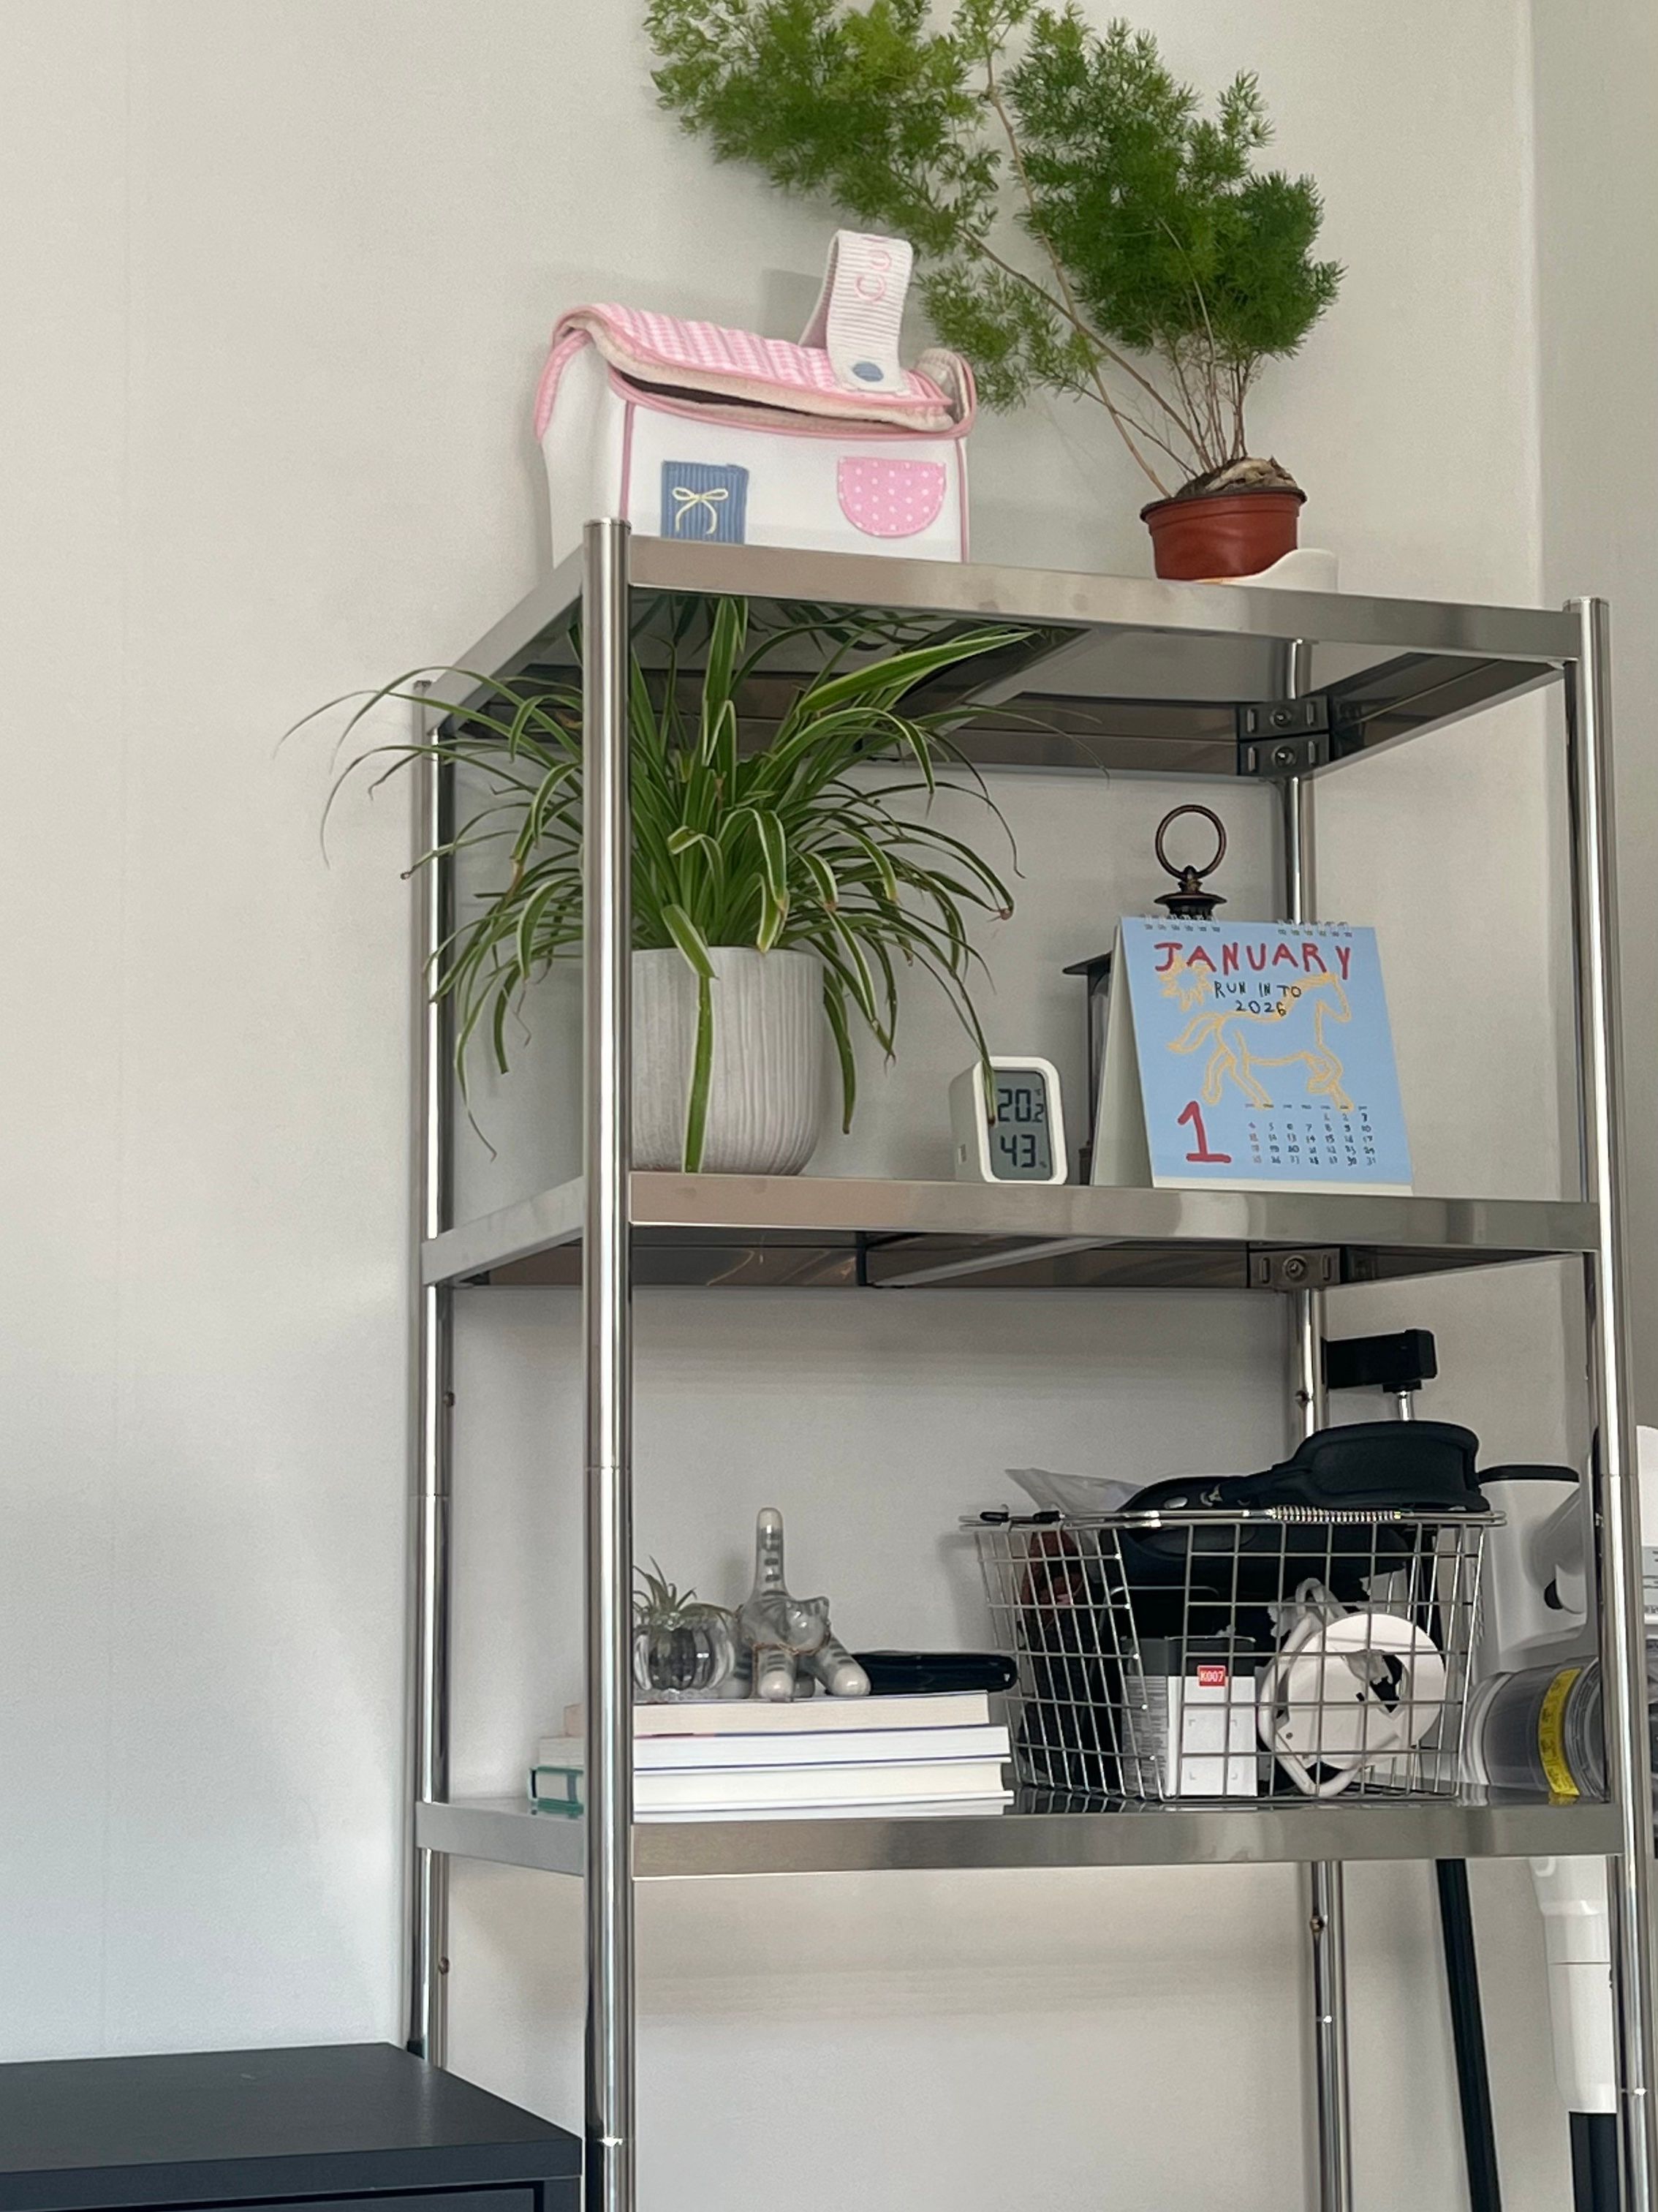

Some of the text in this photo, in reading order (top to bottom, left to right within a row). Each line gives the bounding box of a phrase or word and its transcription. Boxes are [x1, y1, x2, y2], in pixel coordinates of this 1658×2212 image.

[1154, 941, 1351, 981] JANUARY
[1214, 981, 1246, 999] RUN
[1276, 985, 1302, 999] TO
[1235, 1000, 1287, 1016] 2026
[1177, 1101, 1232, 1164] 1
[1000, 1134, 1036, 1168] 43
